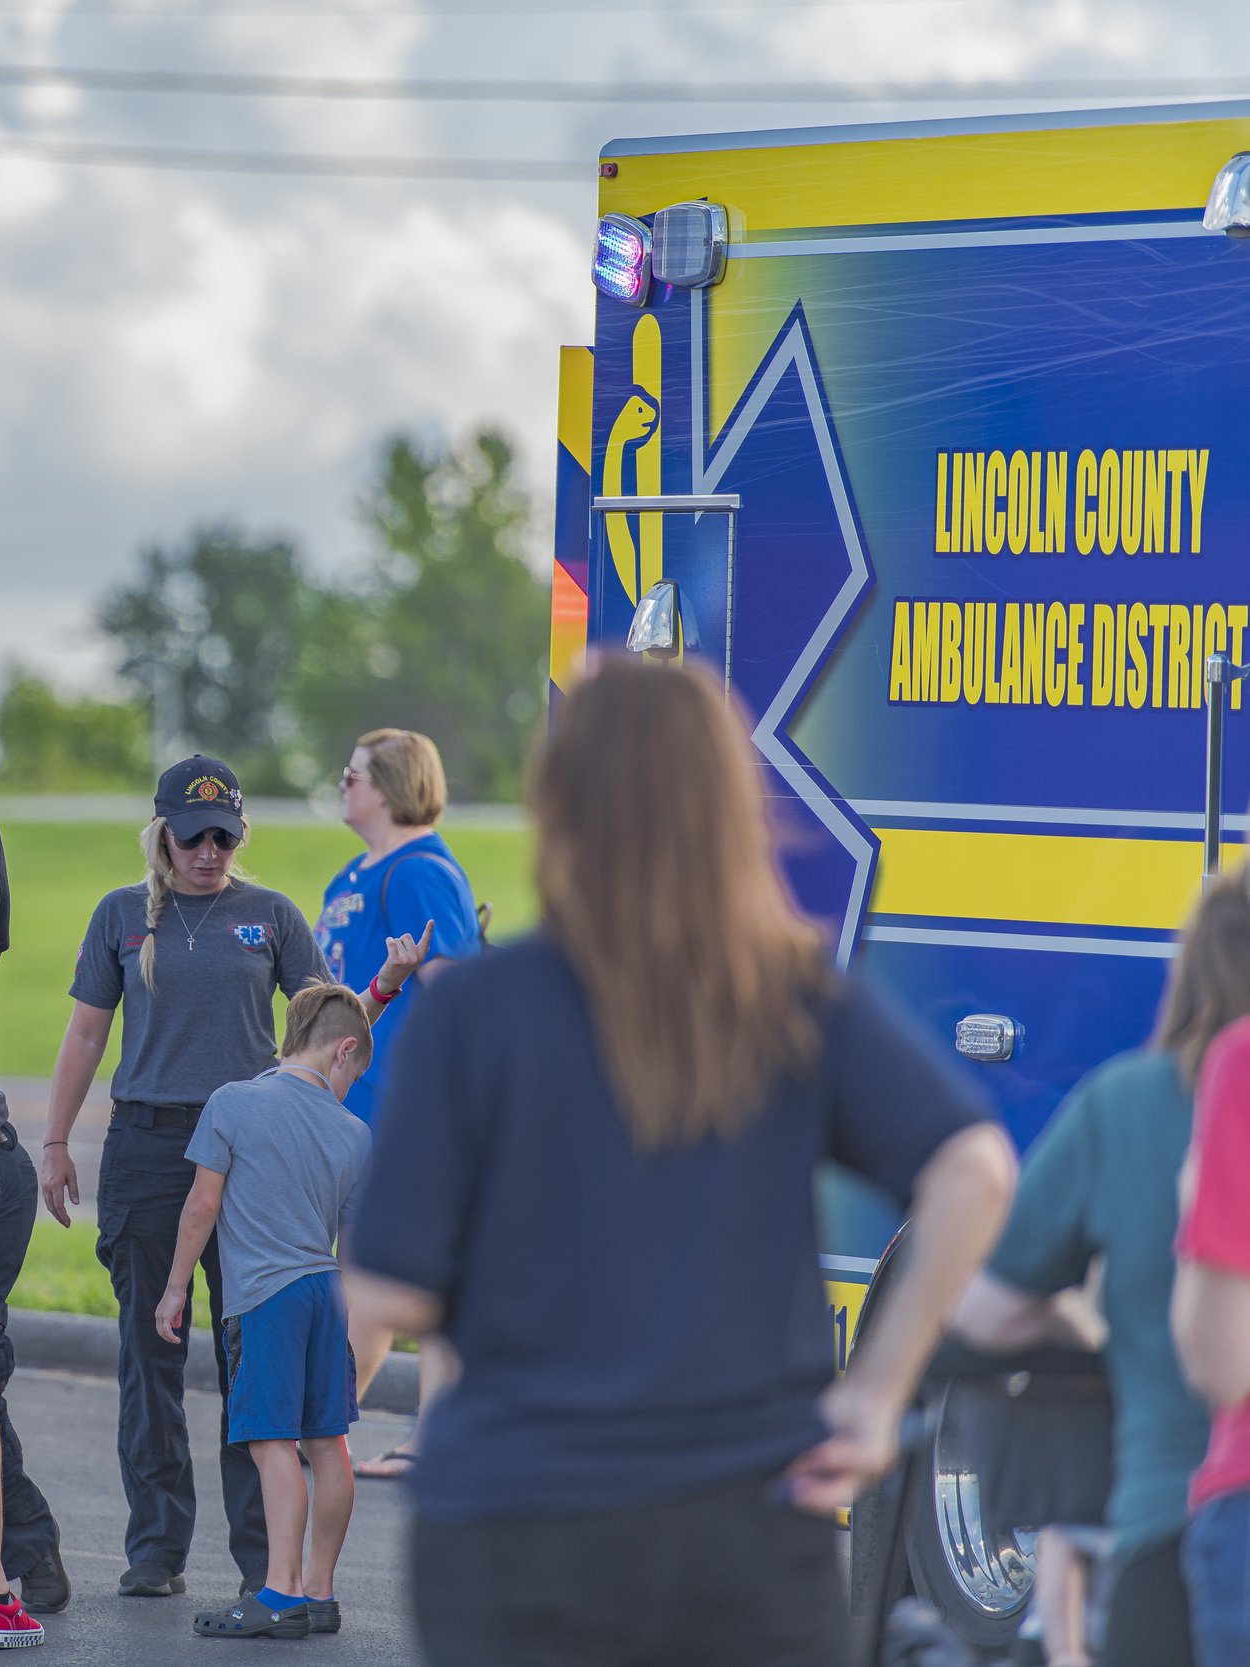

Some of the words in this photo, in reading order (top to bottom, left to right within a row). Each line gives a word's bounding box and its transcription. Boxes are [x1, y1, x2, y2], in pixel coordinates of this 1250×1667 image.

[935, 449, 1068, 555] LINCOLN
[1075, 448, 1209, 555] COUNTY
[889, 601, 1085, 707] AMBULANCE
[1091, 602, 1248, 710] DISTRICT
[184, 775, 208, 795] LINCOLN
